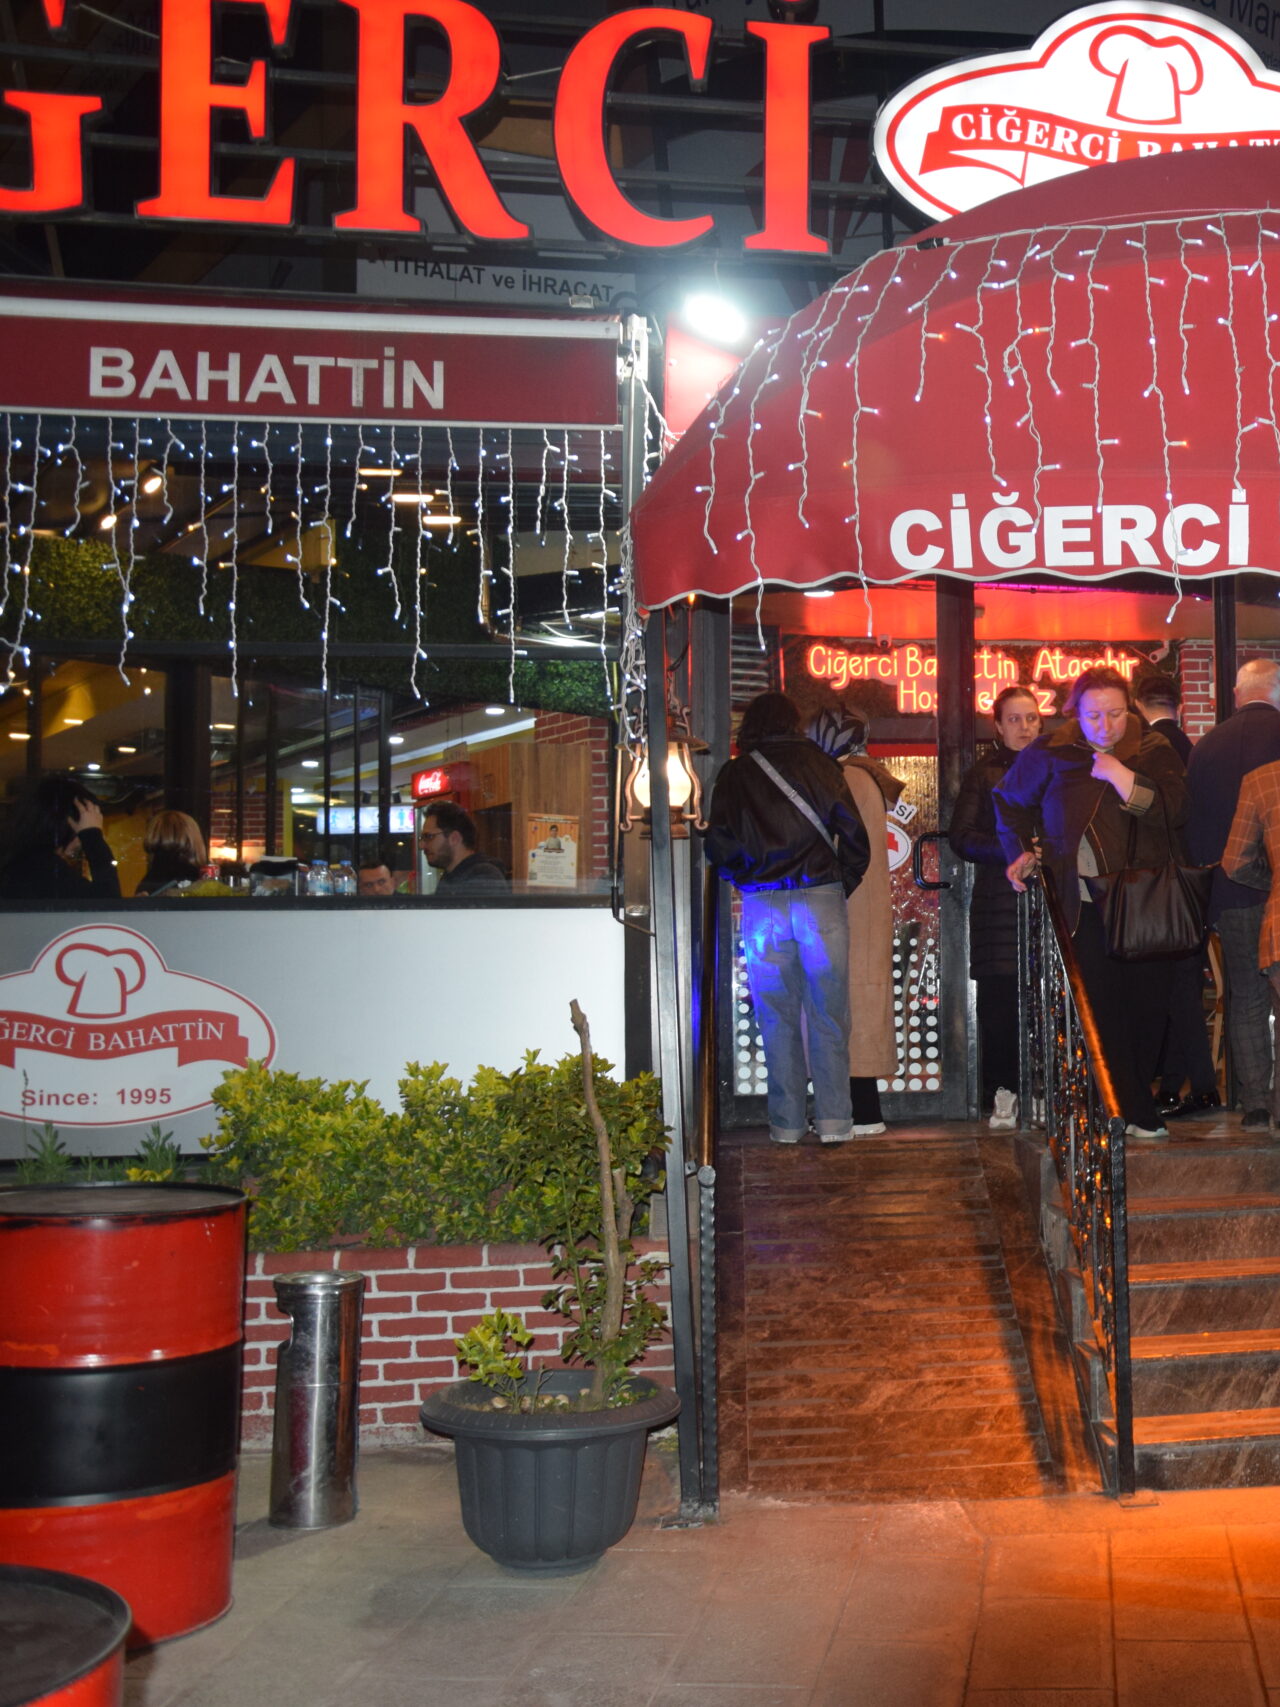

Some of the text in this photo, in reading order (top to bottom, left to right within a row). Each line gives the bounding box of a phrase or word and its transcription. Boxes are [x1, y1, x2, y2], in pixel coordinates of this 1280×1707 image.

[951, 108, 1120, 164] CİĞERCİ
[492, 274, 515, 289] ve
[89, 345, 445, 410] BAHATTİN
[888, 489, 1251, 570] CİĞERCİ
[809, 645, 898, 688] Ciğerci
[88, 1017, 226, 1051] BAHATTİN
[21, 1088, 172, 1106] Since: 1995
